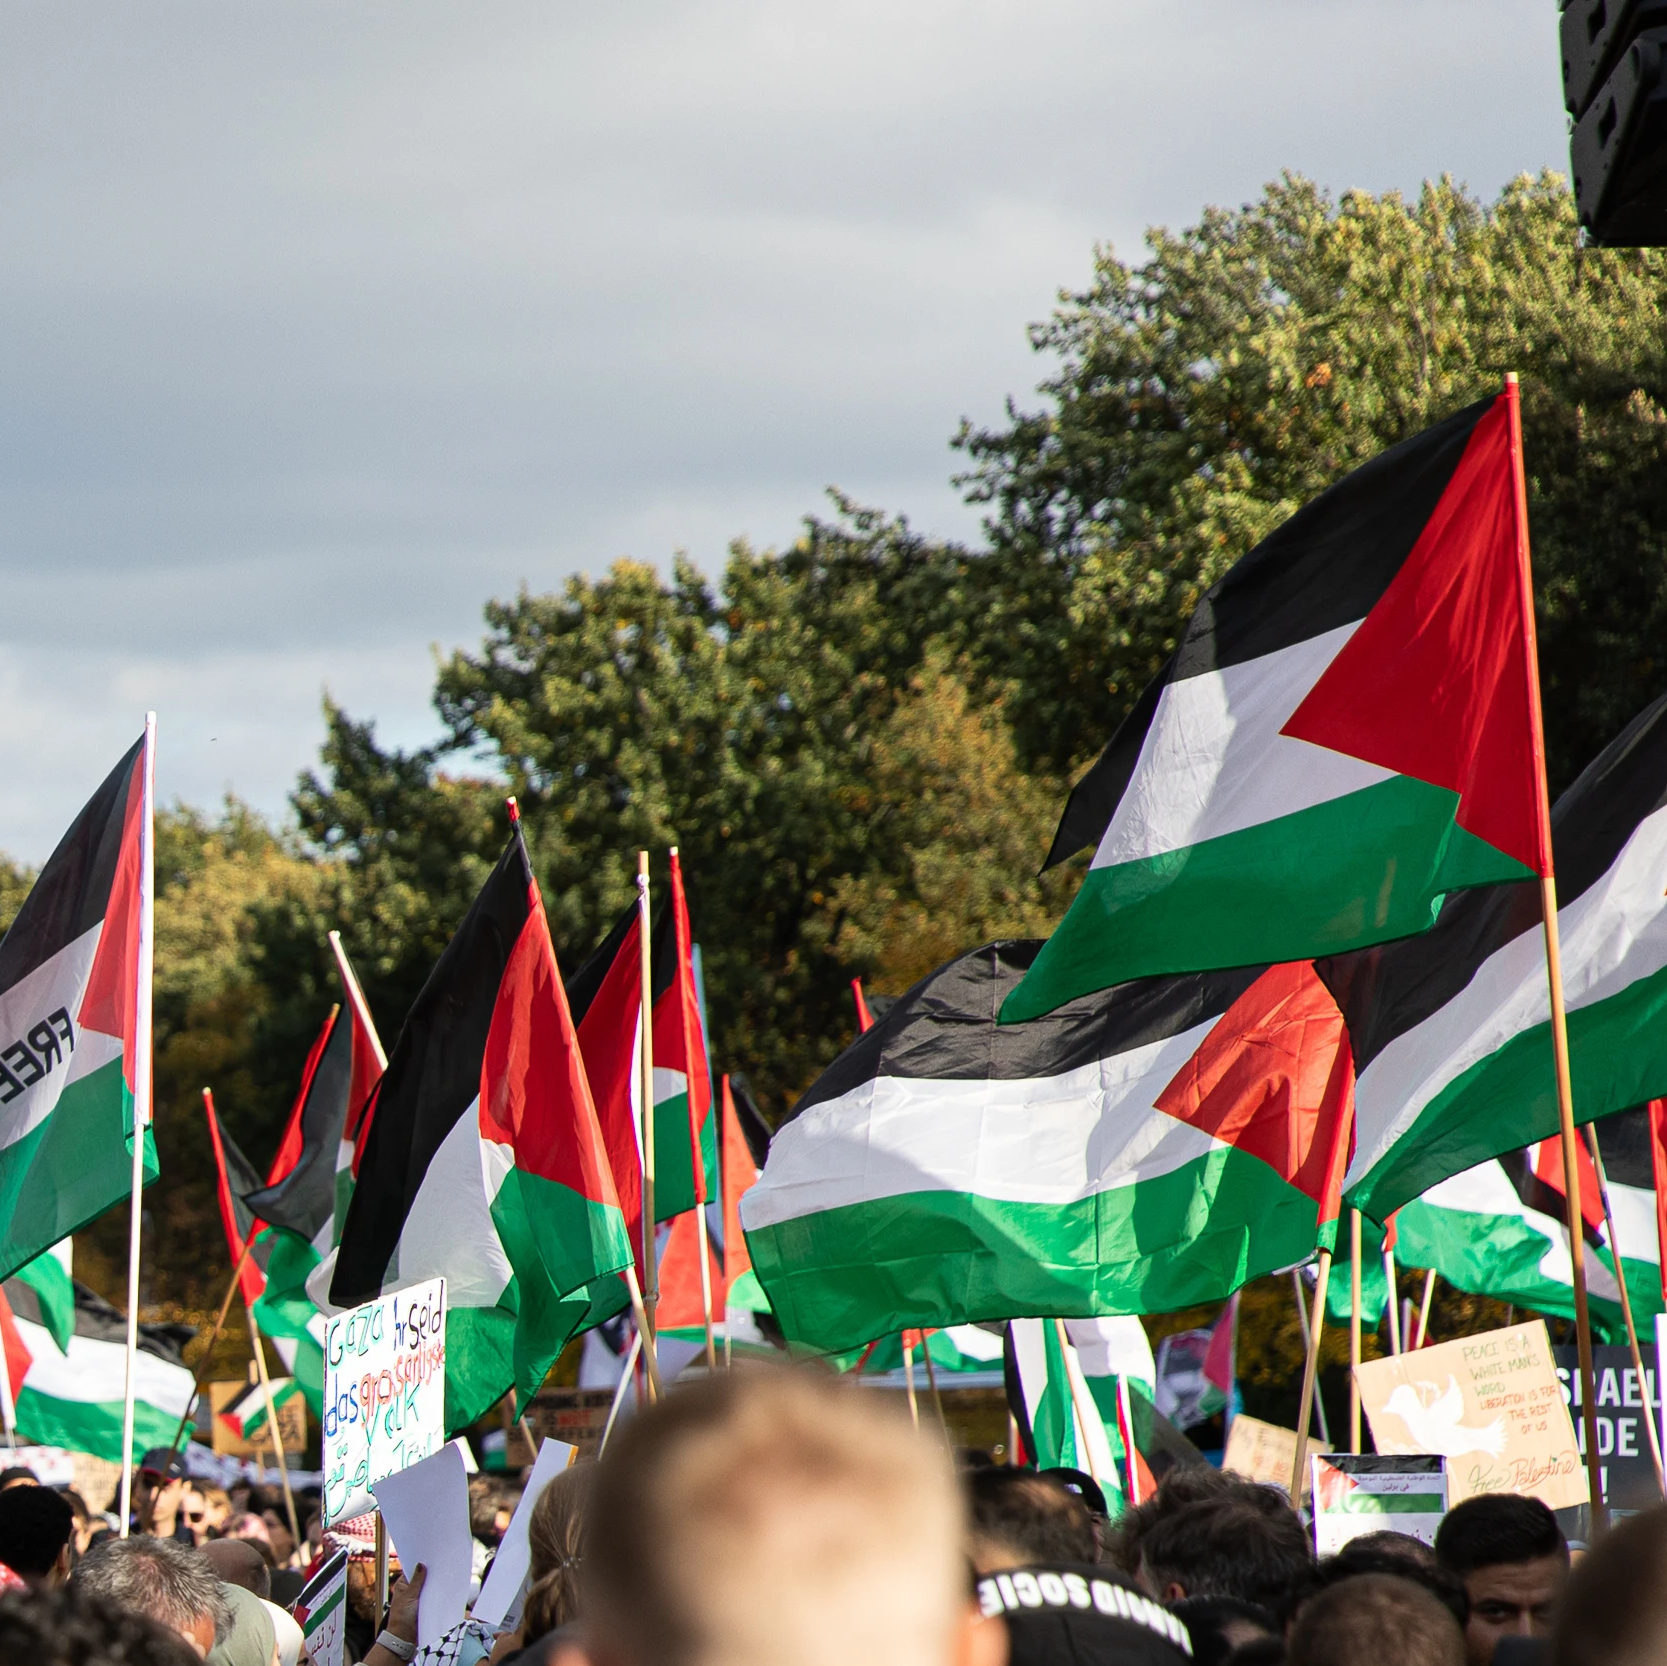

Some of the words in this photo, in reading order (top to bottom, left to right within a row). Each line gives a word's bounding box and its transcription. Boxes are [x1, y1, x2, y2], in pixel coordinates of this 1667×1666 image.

[328, 1303, 385, 1371] Gaza
[1474, 1382, 1506, 1397] WORD
[325, 1373, 359, 1437] das
[1507, 1409, 1528, 1421] THE
[1529, 1402, 1553, 1416] REST
[1521, 1424, 1532, 1434] OF
[1535, 1421, 1548, 1431] US
